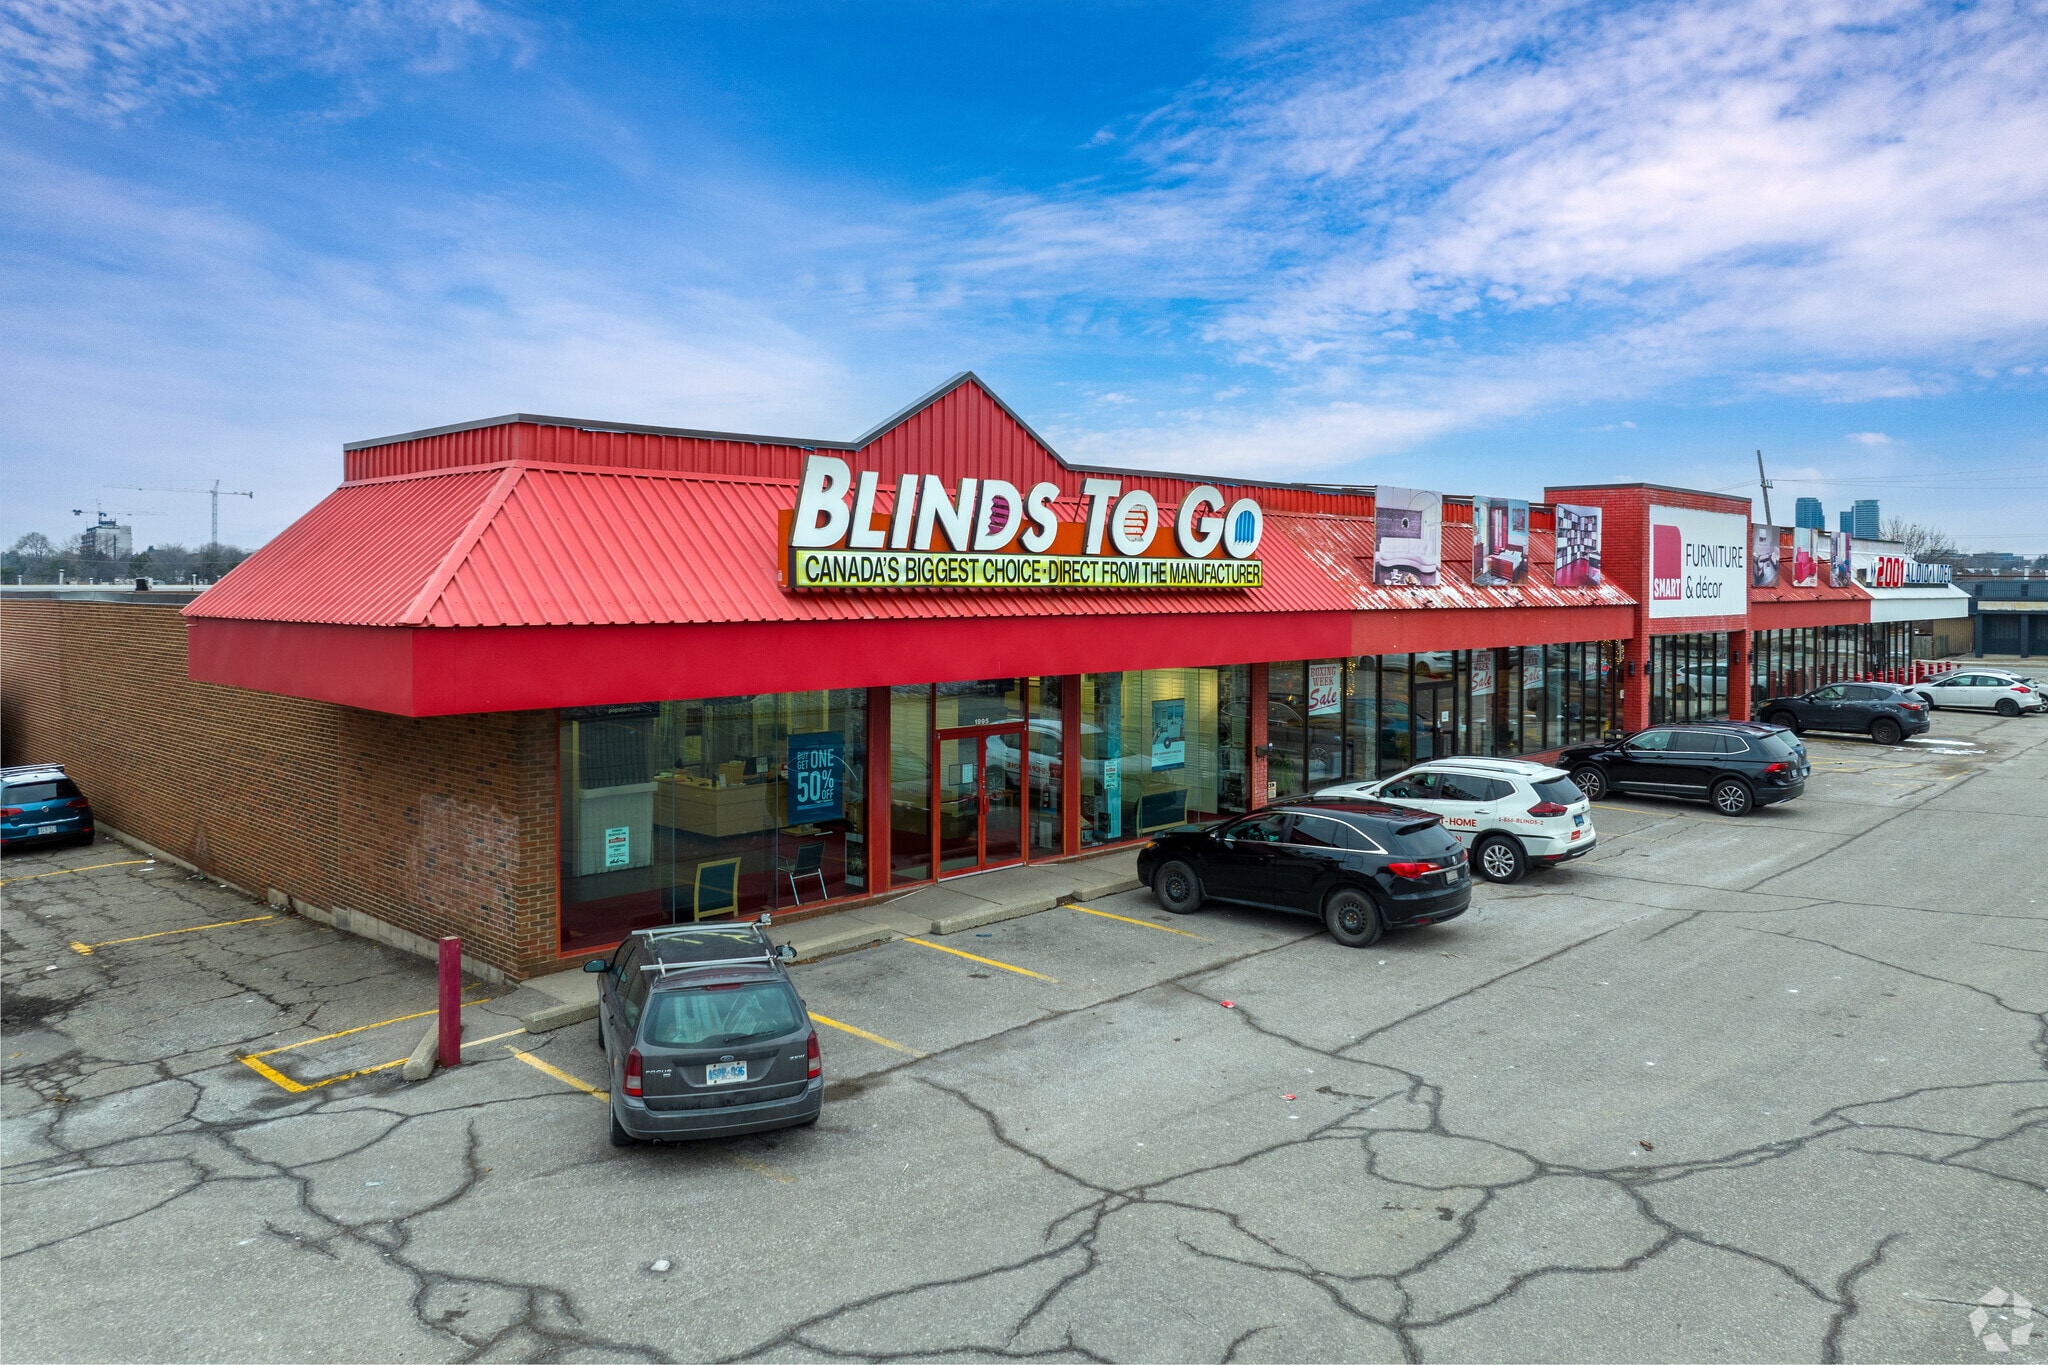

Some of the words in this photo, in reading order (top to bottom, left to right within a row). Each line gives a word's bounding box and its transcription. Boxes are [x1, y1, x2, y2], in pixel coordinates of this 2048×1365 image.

[789, 455, 1060, 553] BLINDS
[1081, 478, 1158, 556] TO
[1174, 485, 1263, 559] GO
[1686, 543, 1743, 569] FURNITURE
[805, 555, 899, 583] CANADA'S
[905, 557, 979, 583] BIGGEST
[983, 558, 1040, 583] CHOICE
[1049, 560, 1098, 583] DIRECT
[1102, 561, 1139, 583] FROM
[1143, 561, 1167, 583] THE
[1169, 562, 1260, 584] MANUFACTURER
[1876, 556, 1904, 587] 2001
[1653, 578, 1681, 598] SMART
[1685, 576, 1694, 599] &
[1695, 576, 1722, 599] décor
[1310, 666, 1337, 677] BOXING
[1312, 676, 1334, 687] WEEK
[1472, 671, 1492, 691] Sale
[1307, 686, 1337, 709] Sale
[797, 751, 809, 761] BUY
[810, 748, 835, 769] ONE
[797, 760, 809, 770] GET
[821, 788, 835, 800] OFF
[1440, 817, 1477, 828] T-HOME
